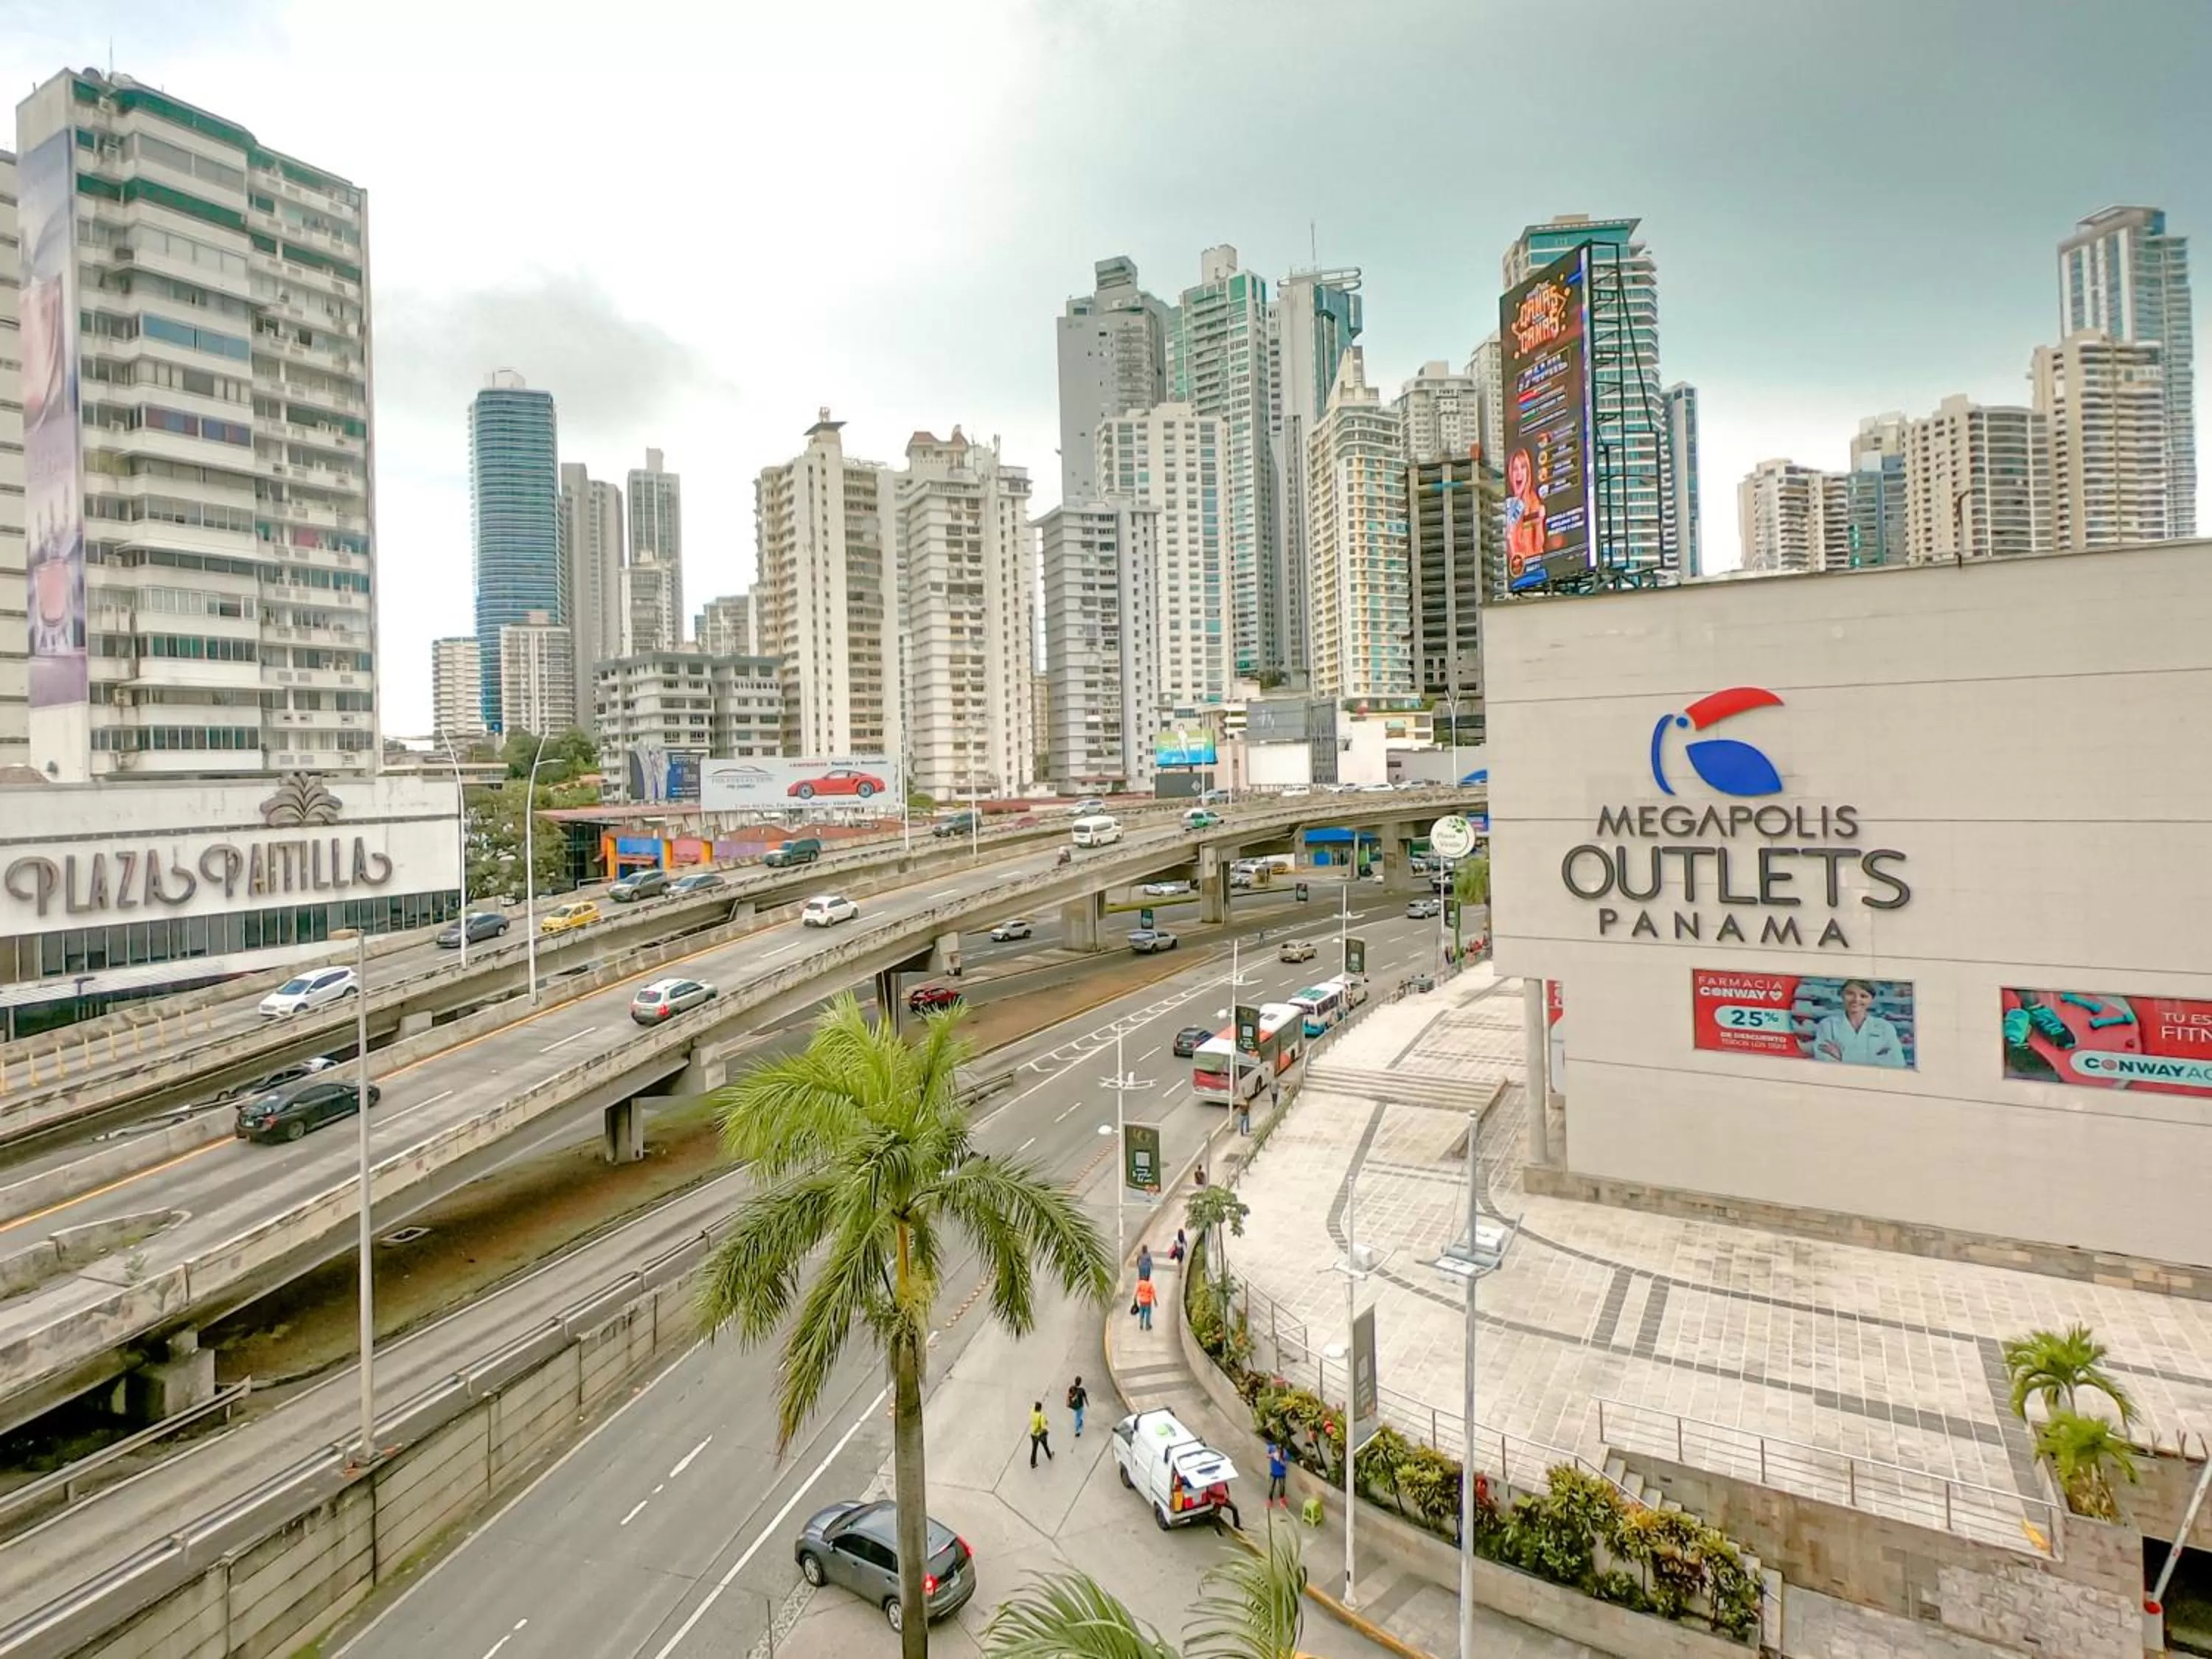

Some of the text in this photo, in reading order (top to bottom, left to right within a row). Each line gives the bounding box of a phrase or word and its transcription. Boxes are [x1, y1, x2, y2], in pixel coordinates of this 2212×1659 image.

[1597, 805, 1858, 838] MEGAPOLIS
[4, 837, 393, 917] PLAZA PAITILLA
[1561, 844, 1910, 909] OUTLETS
[1599, 908, 1848, 947] PANAMA
[1698, 975, 1782, 990] FARMACIA
[1700, 987, 1767, 1000] CONWAY
[2162, 1012, 2185, 1023] TU
